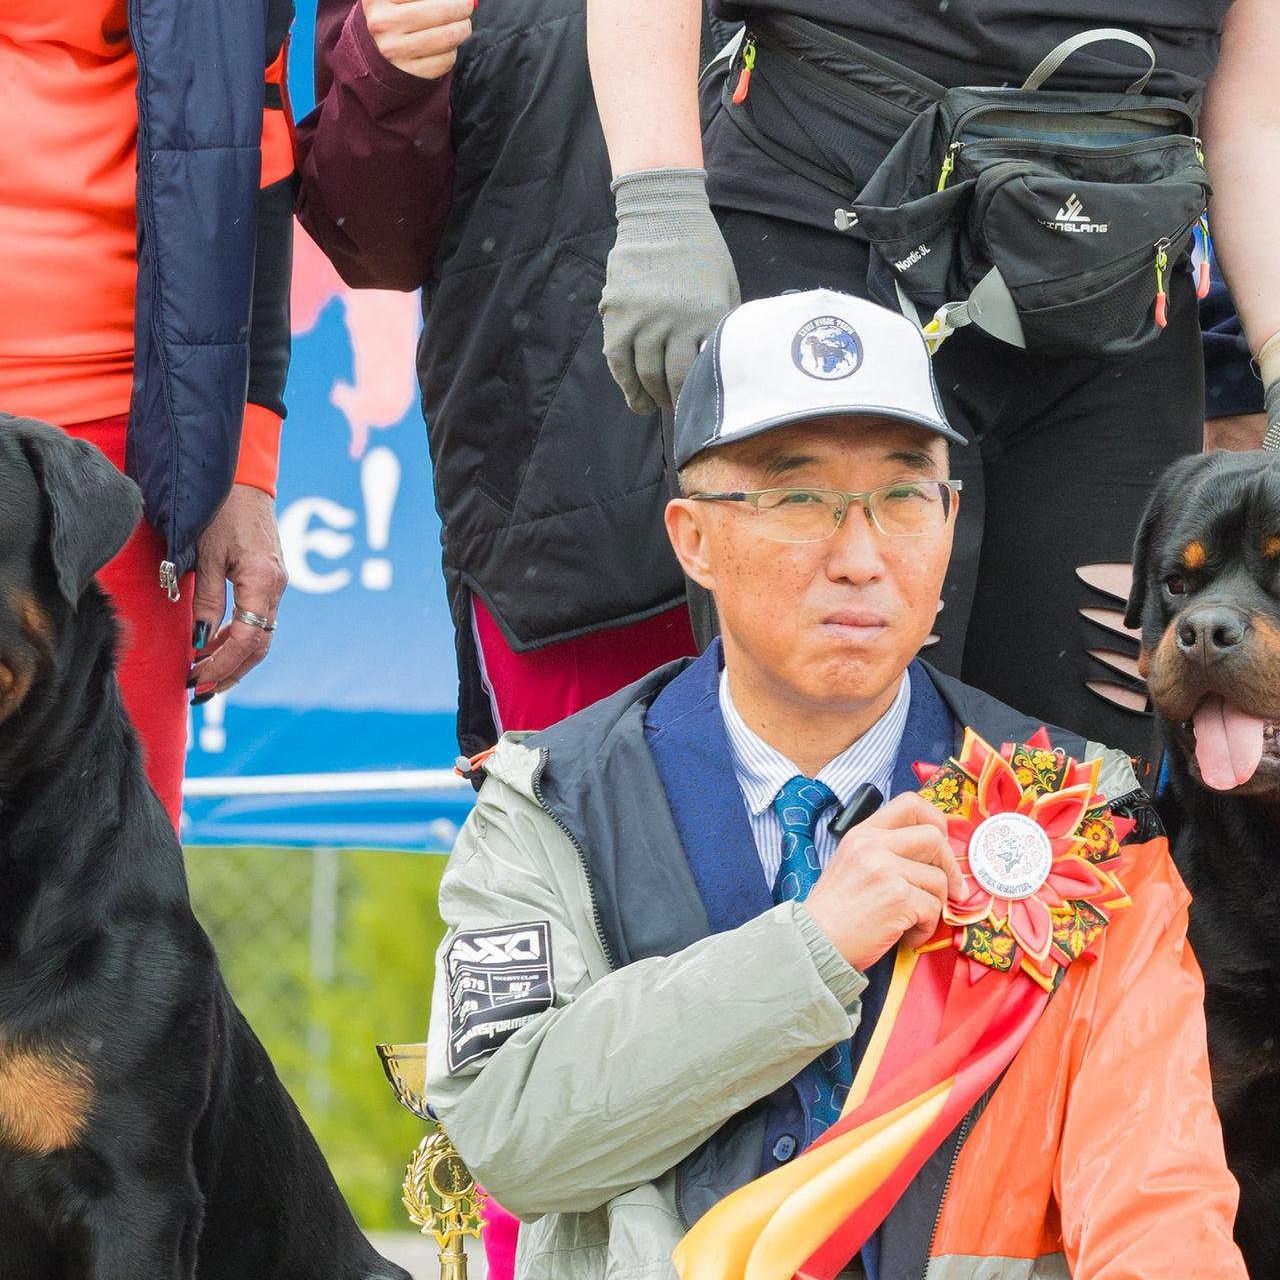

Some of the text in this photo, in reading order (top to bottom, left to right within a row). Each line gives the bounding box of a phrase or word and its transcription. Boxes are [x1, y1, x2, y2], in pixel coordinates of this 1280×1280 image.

[894, 243, 931, 272] Nordic 3L
[454, 1012, 543, 1054] TRANSFORME
